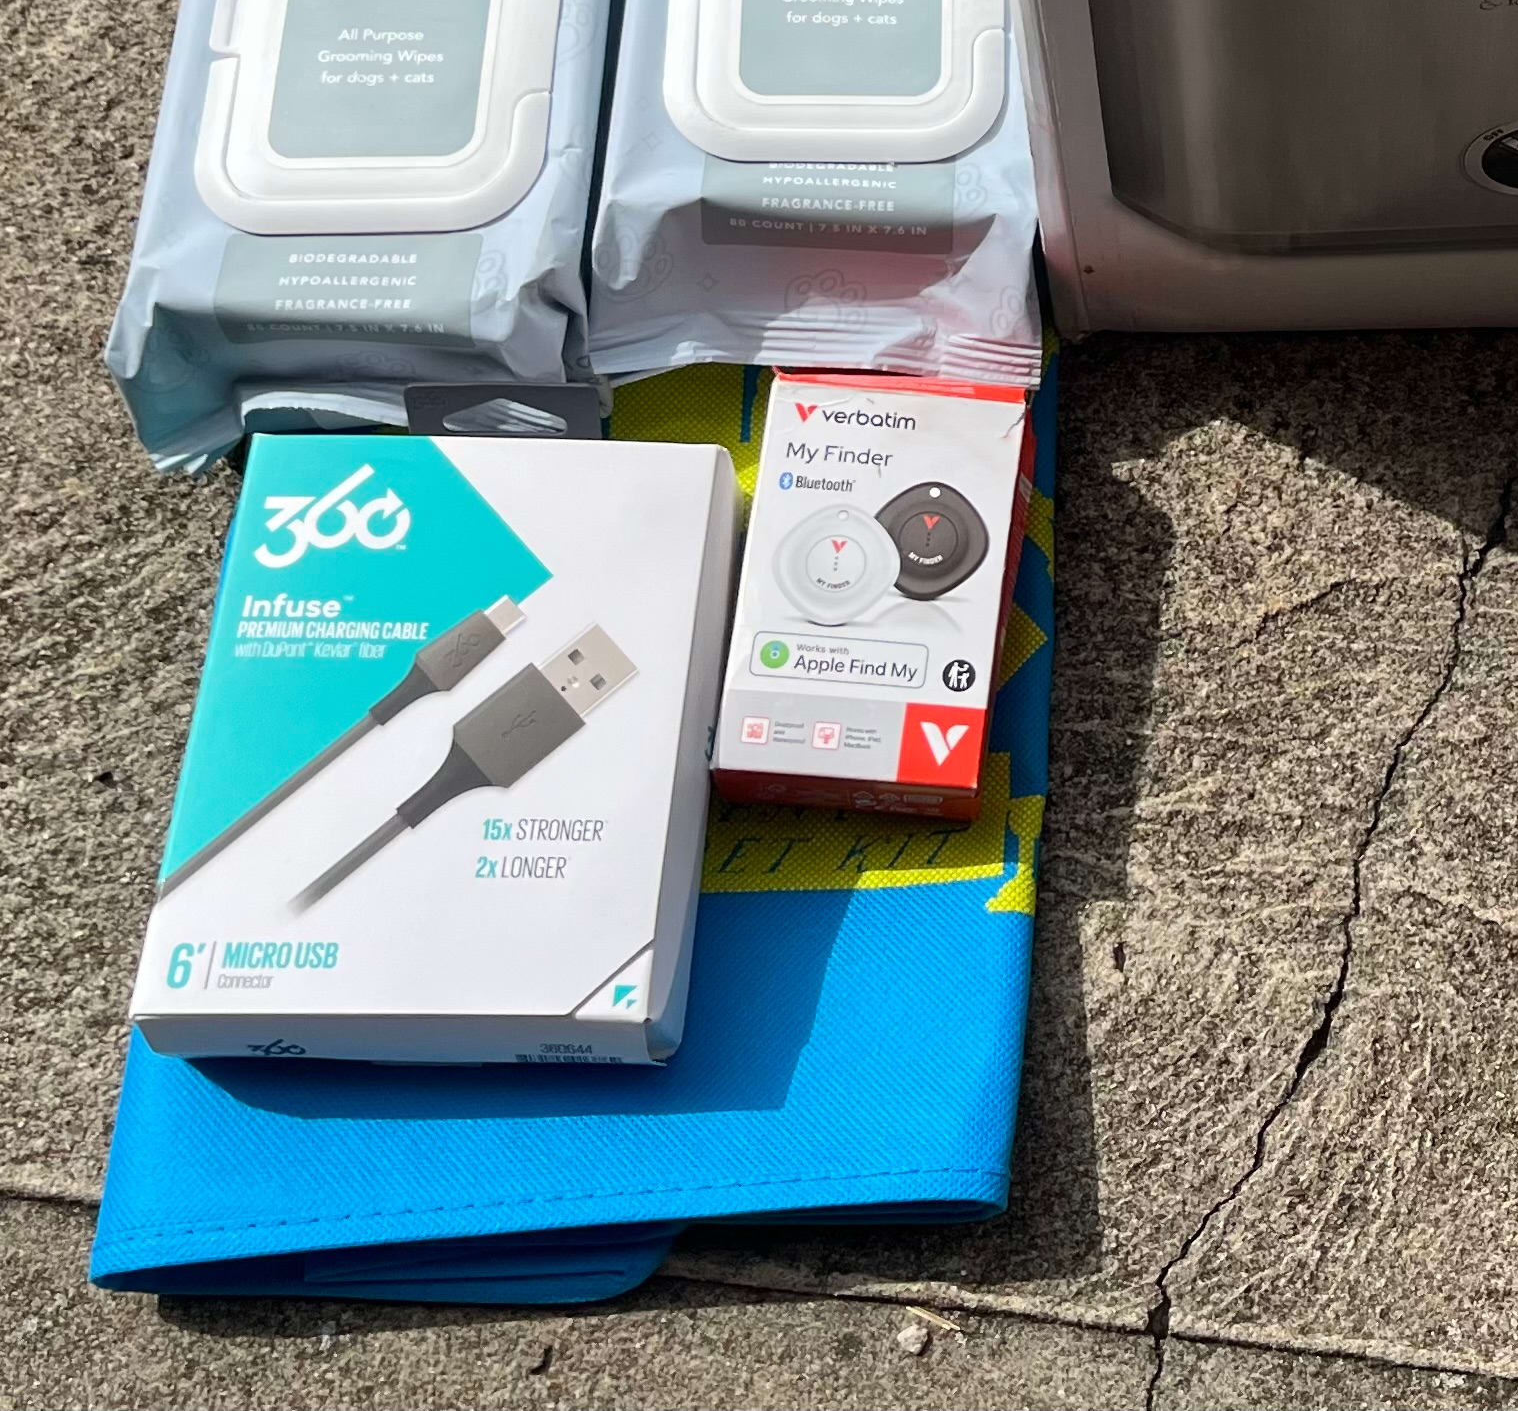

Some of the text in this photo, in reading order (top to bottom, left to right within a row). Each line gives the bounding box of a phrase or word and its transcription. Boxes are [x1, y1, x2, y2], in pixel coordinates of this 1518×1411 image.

[786, 10, 808, 24] for
[811, 11, 849, 27] dogs
[867, 13, 898, 25] cats
[337, 28, 425, 45] All Purpose
[317, 49, 445, 65] Grooming Wipes
[320, 70, 344, 84] for
[346, 70, 385, 87] dogs
[404, 72, 435, 84] cats
[761, 176, 897, 189] HYPOALLERGENIC
[760, 197, 896, 212] FRAGRANCE-FREE
[751, 219, 804, 231] COUNT
[846, 224, 862, 234] IN
[910, 225, 928, 236] IN
[288, 253, 419, 265] BIODEGRADABLE
[278, 275, 418, 287] HYPOALLERGENIC
[274, 298, 413, 312] FRAGRANCE-FREE
[428, 323, 446, 335] IN
[821, 408, 917, 431] verbatim
[785, 441, 894, 467] My Finder
[795, 474, 853, 493] Bluetooth
[253, 462, 412, 569] 360
[241, 592, 342, 619] Infuse
[236, 620, 430, 641] PREMIUM CHARGING CABLE
[234, 641, 387, 659] with DuPont Kevlar fiber
[796, 642, 850, 656] Works with
[793, 654, 918, 684] Apple Find My
[482, 818, 605, 842] 15x STRONGER
[474, 855, 567, 879] 2x LONGER
[220, 941, 293, 969] MICRO
[292, 941, 340, 970] USB
[216, 973, 275, 990] Connector
